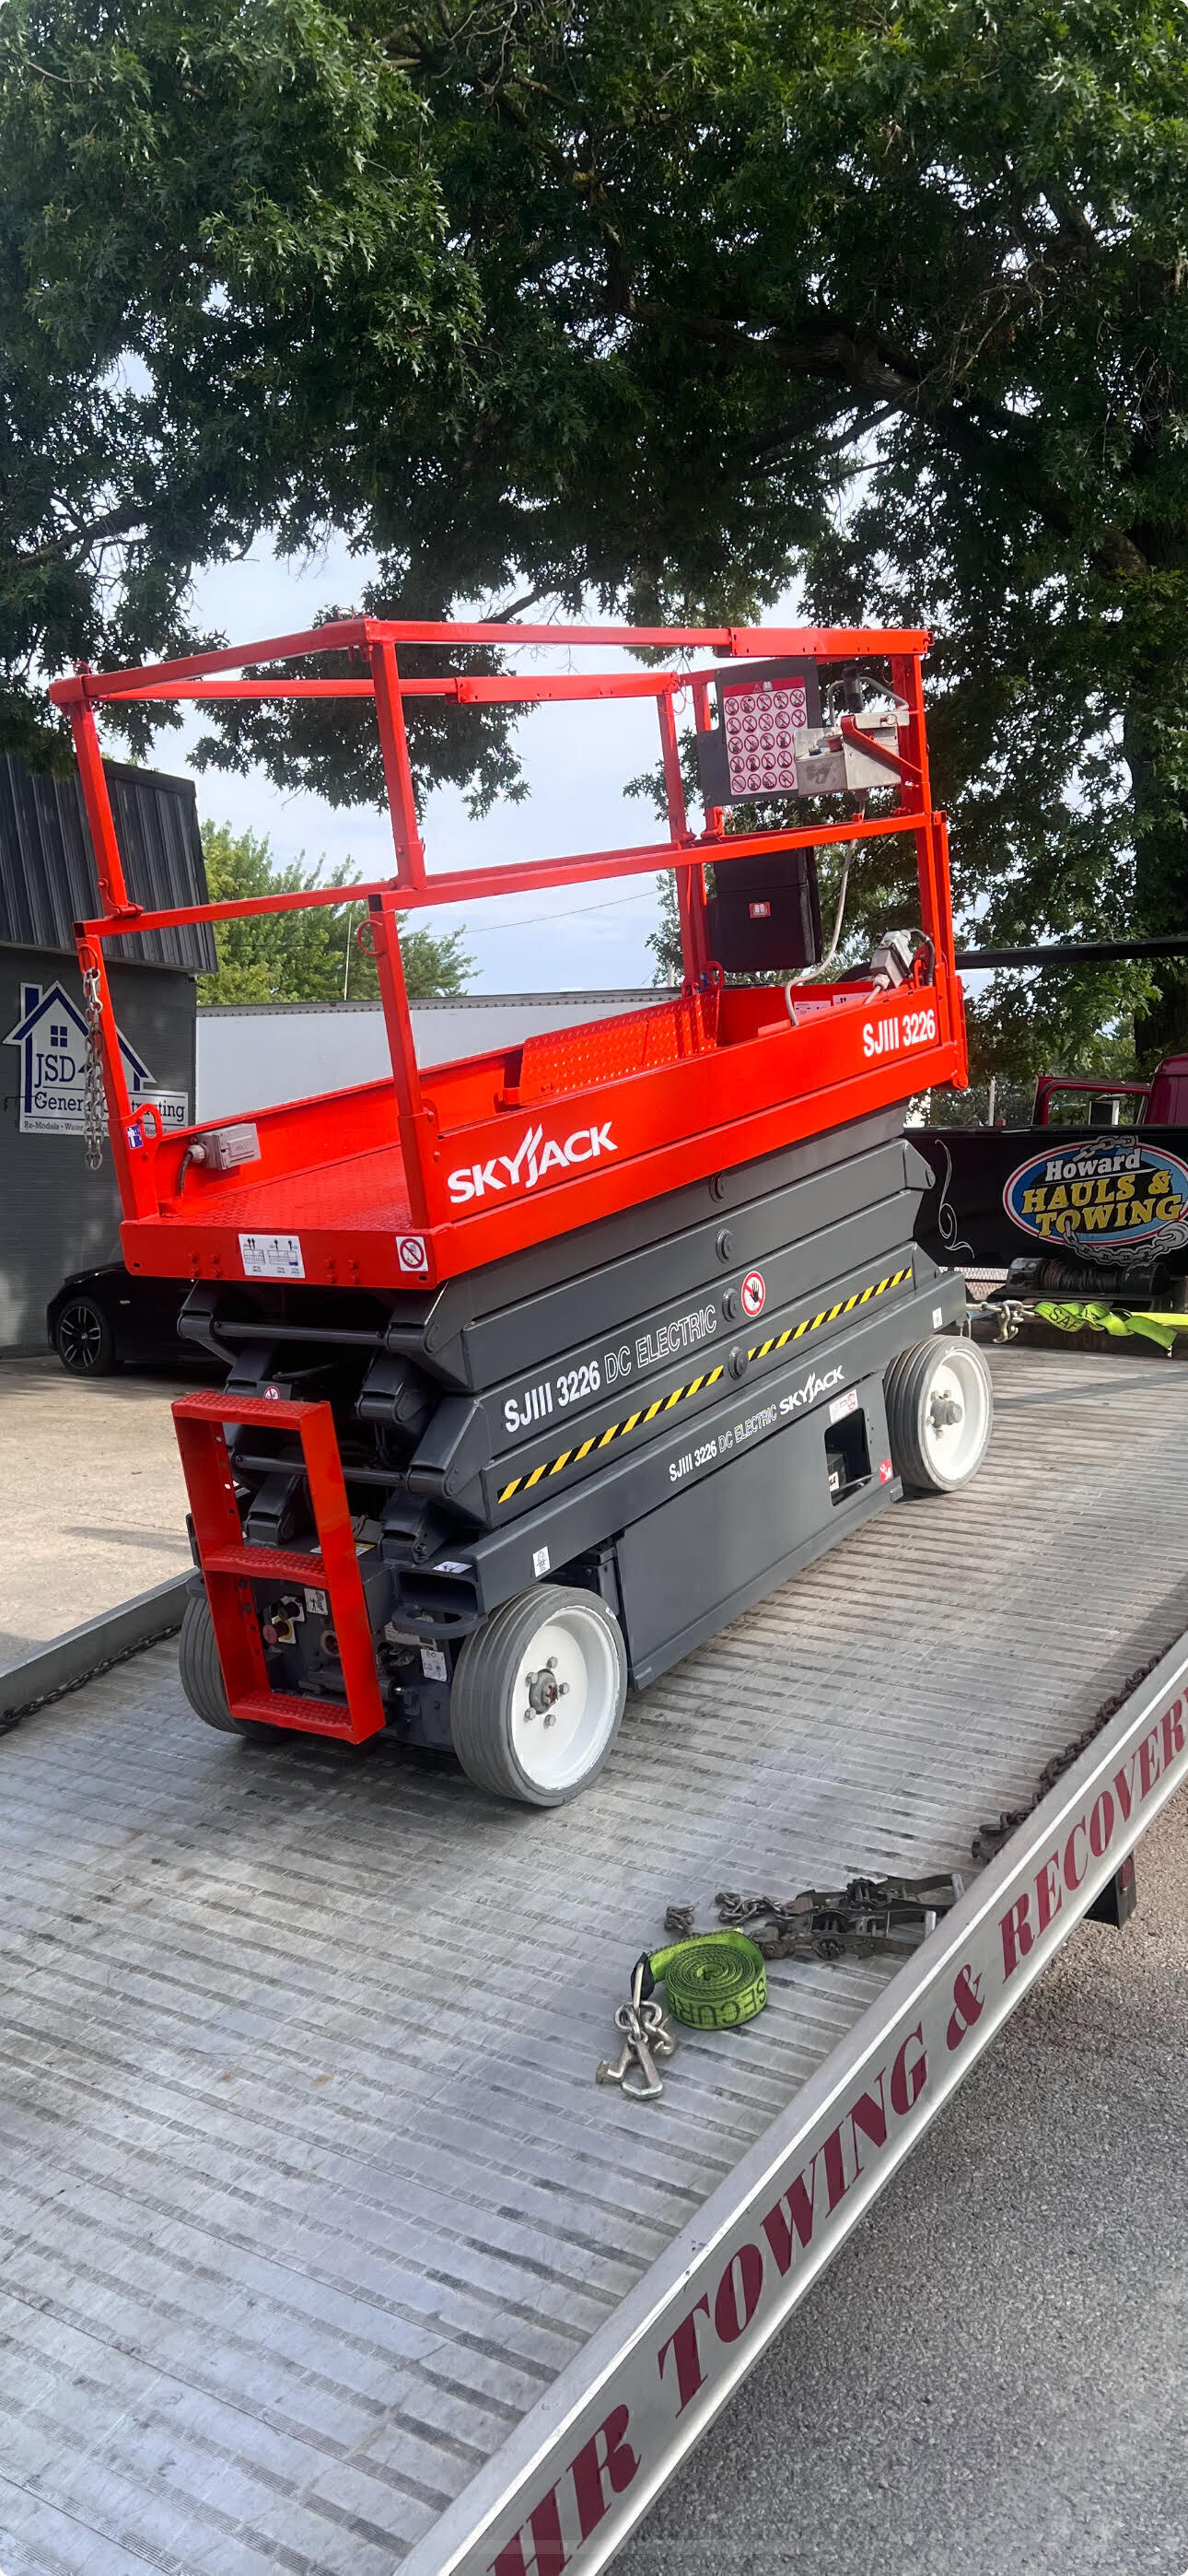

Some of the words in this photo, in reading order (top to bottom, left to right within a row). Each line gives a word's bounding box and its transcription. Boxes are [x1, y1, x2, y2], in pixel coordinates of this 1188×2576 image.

[863, 1017, 899, 1057] SJIII
[903, 1009, 936, 1047] 3226
[34, 1053, 76, 1088] JSD
[34, 1091, 89, 1112] Gener
[448, 1121, 619, 1203] SKYJACK
[1044, 1148, 1142, 1182] Howard
[1021, 1174, 1136, 1214] HAULS
[1147, 1170, 1172, 1195] &
[1035, 1193, 1183, 1237] TOWING
[504, 1382, 553, 1433] SJIII
[556, 1361, 600, 1407] 3226
[604, 1346, 632, 1384] DC
[635, 1305, 717, 1369] ELECTRIC
[669, 1455, 693, 1481] SJIII
[693, 1440, 717, 1468] 3226
[718, 1431, 734, 1453] DC
[734, 1404, 777, 1444] ELECTRIC
[779, 1364, 845, 1415] SKYJACK
[658, 2022, 928, 2419] TOWING
[947, 1963, 985, 2051] &
[998, 1686, 1188, 1984] RECOVER
